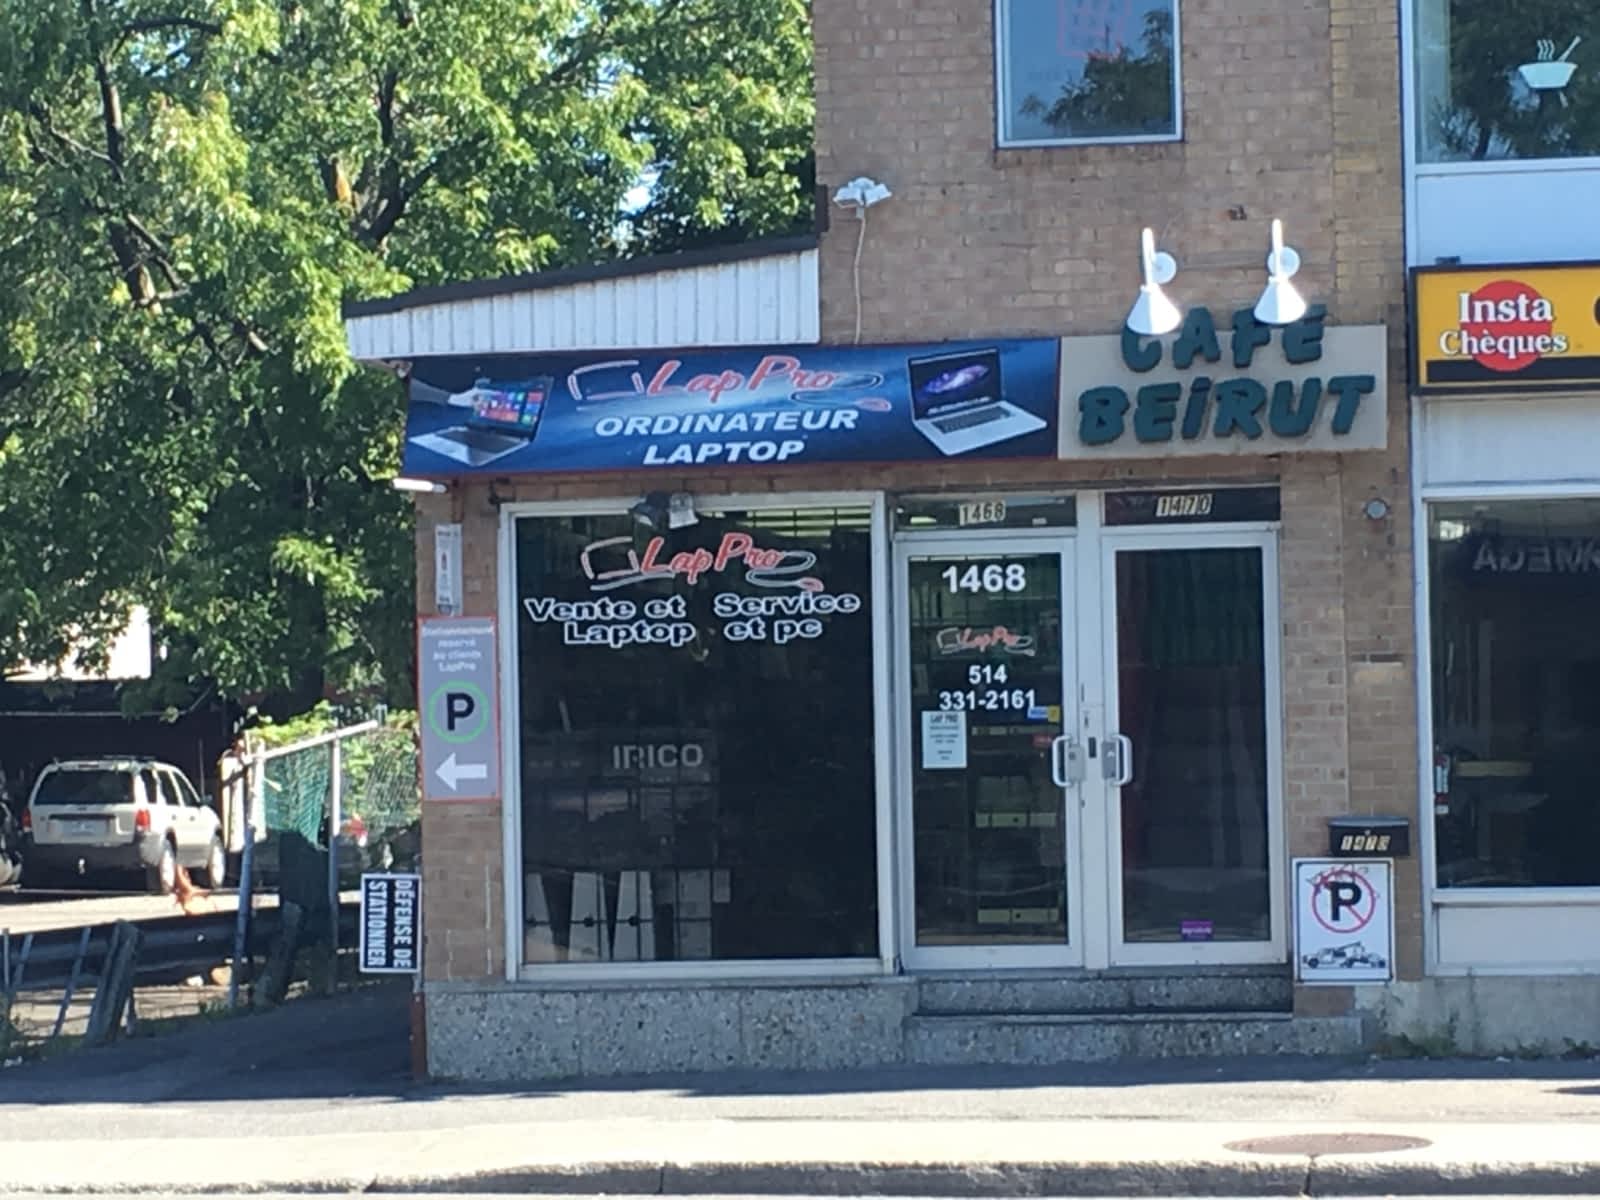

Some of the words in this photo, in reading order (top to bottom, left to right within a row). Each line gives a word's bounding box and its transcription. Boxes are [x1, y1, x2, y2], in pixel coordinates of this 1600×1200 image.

[1458, 292, 1554, 323] Insta
[1439, 328, 1569, 361] Chèques
[594, 408, 859, 437] ORDINATEUR
[642, 439, 805, 466] LAPTOP
[960, 501, 1006, 523] 1468
[1158, 495, 1212, 517] 1470
[941, 563, 1026, 594] 1468
[524, 597, 636, 622] Vente
[644, 595, 687, 620] et
[713, 592, 861, 618] Service
[564, 620, 697, 648] Laptop
[724, 617, 767, 641] et
[774, 619, 823, 645] pc
[968, 663, 1008, 685] 514
[446, 692, 475, 731] P
[939, 689, 1036, 711] 331-2161
[1329, 881, 1362, 921] P
[367, 880, 388, 966] STATIONNER
[393, 948, 412, 968] DE
